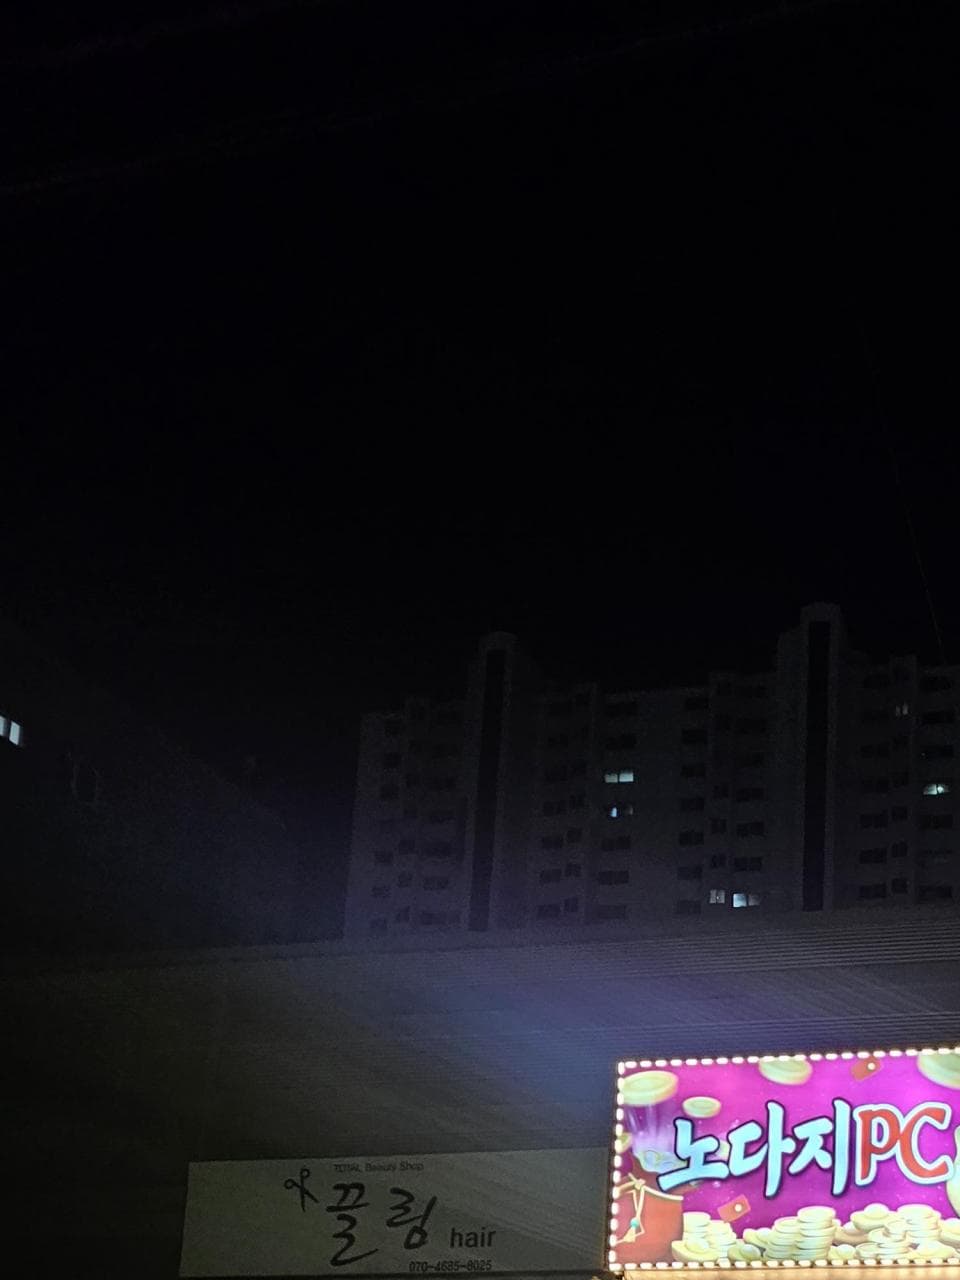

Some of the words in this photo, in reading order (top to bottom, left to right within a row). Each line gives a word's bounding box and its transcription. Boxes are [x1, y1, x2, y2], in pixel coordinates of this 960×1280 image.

[656, 1097, 955, 1199] 노다지PC
[400, 1160, 425, 1172] Shop
[450, 1226, 497, 1248] hair
